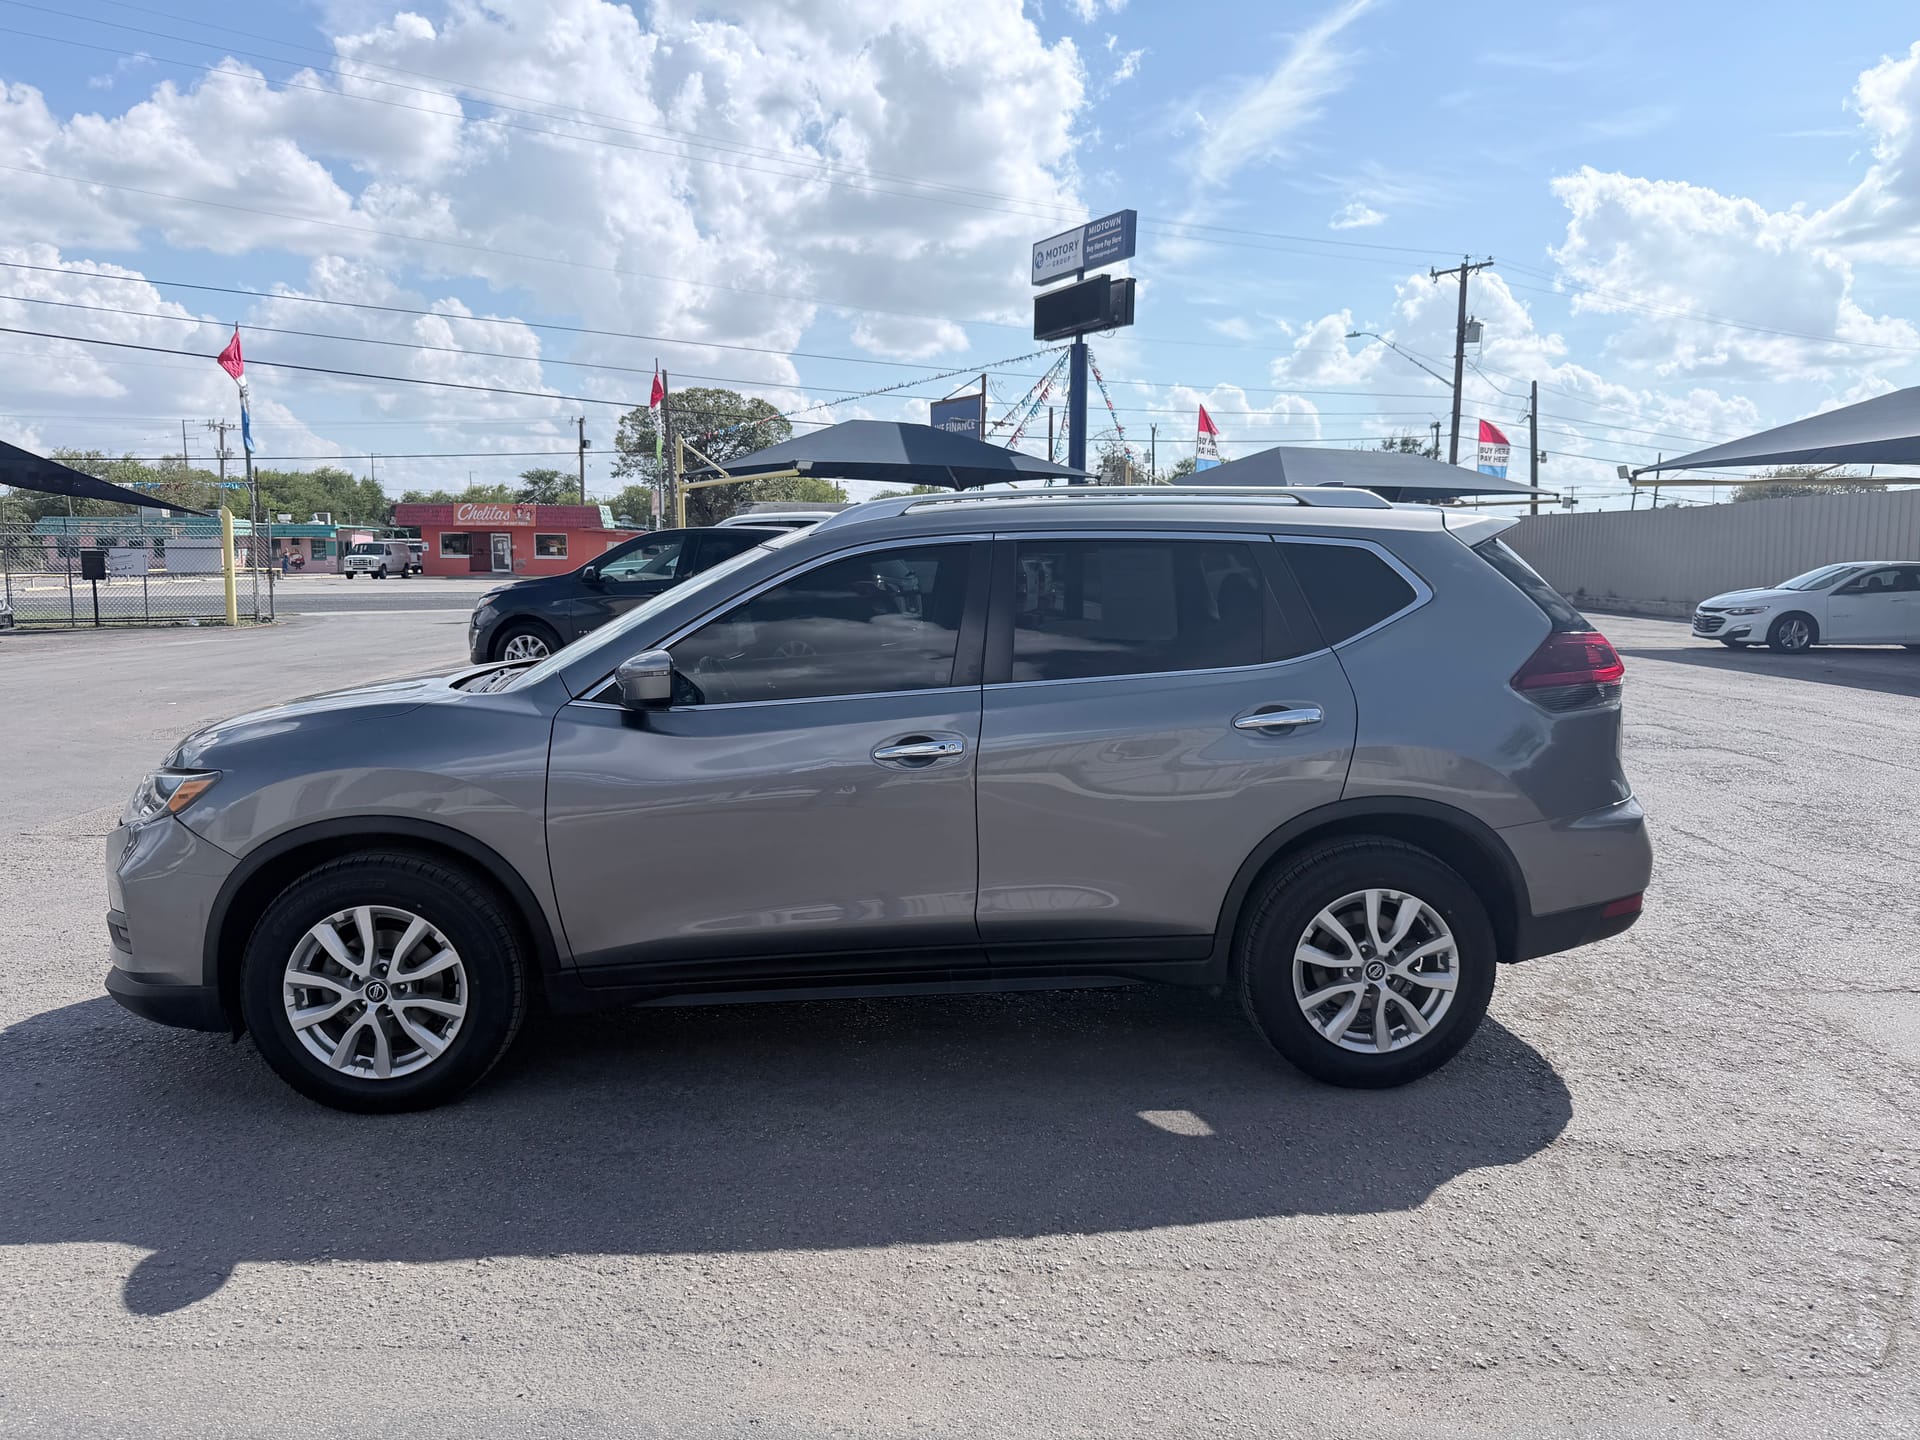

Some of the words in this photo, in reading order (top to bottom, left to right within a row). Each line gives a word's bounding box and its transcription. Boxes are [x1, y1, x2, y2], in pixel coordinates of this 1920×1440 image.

[1088, 215, 1122, 235] MIDTOWN
[1045, 239, 1080, 261] MOTORY
[1052, 255, 1071, 268] GROUP
[945, 421, 976, 433] FINANCE
[1479, 446, 1494, 455] BUY
[1494, 447, 1511, 456] HERE
[1479, 454, 1493, 462] PAY
[1493, 455, 1510, 463] HERE
[457, 503, 511, 521] Chelitas
